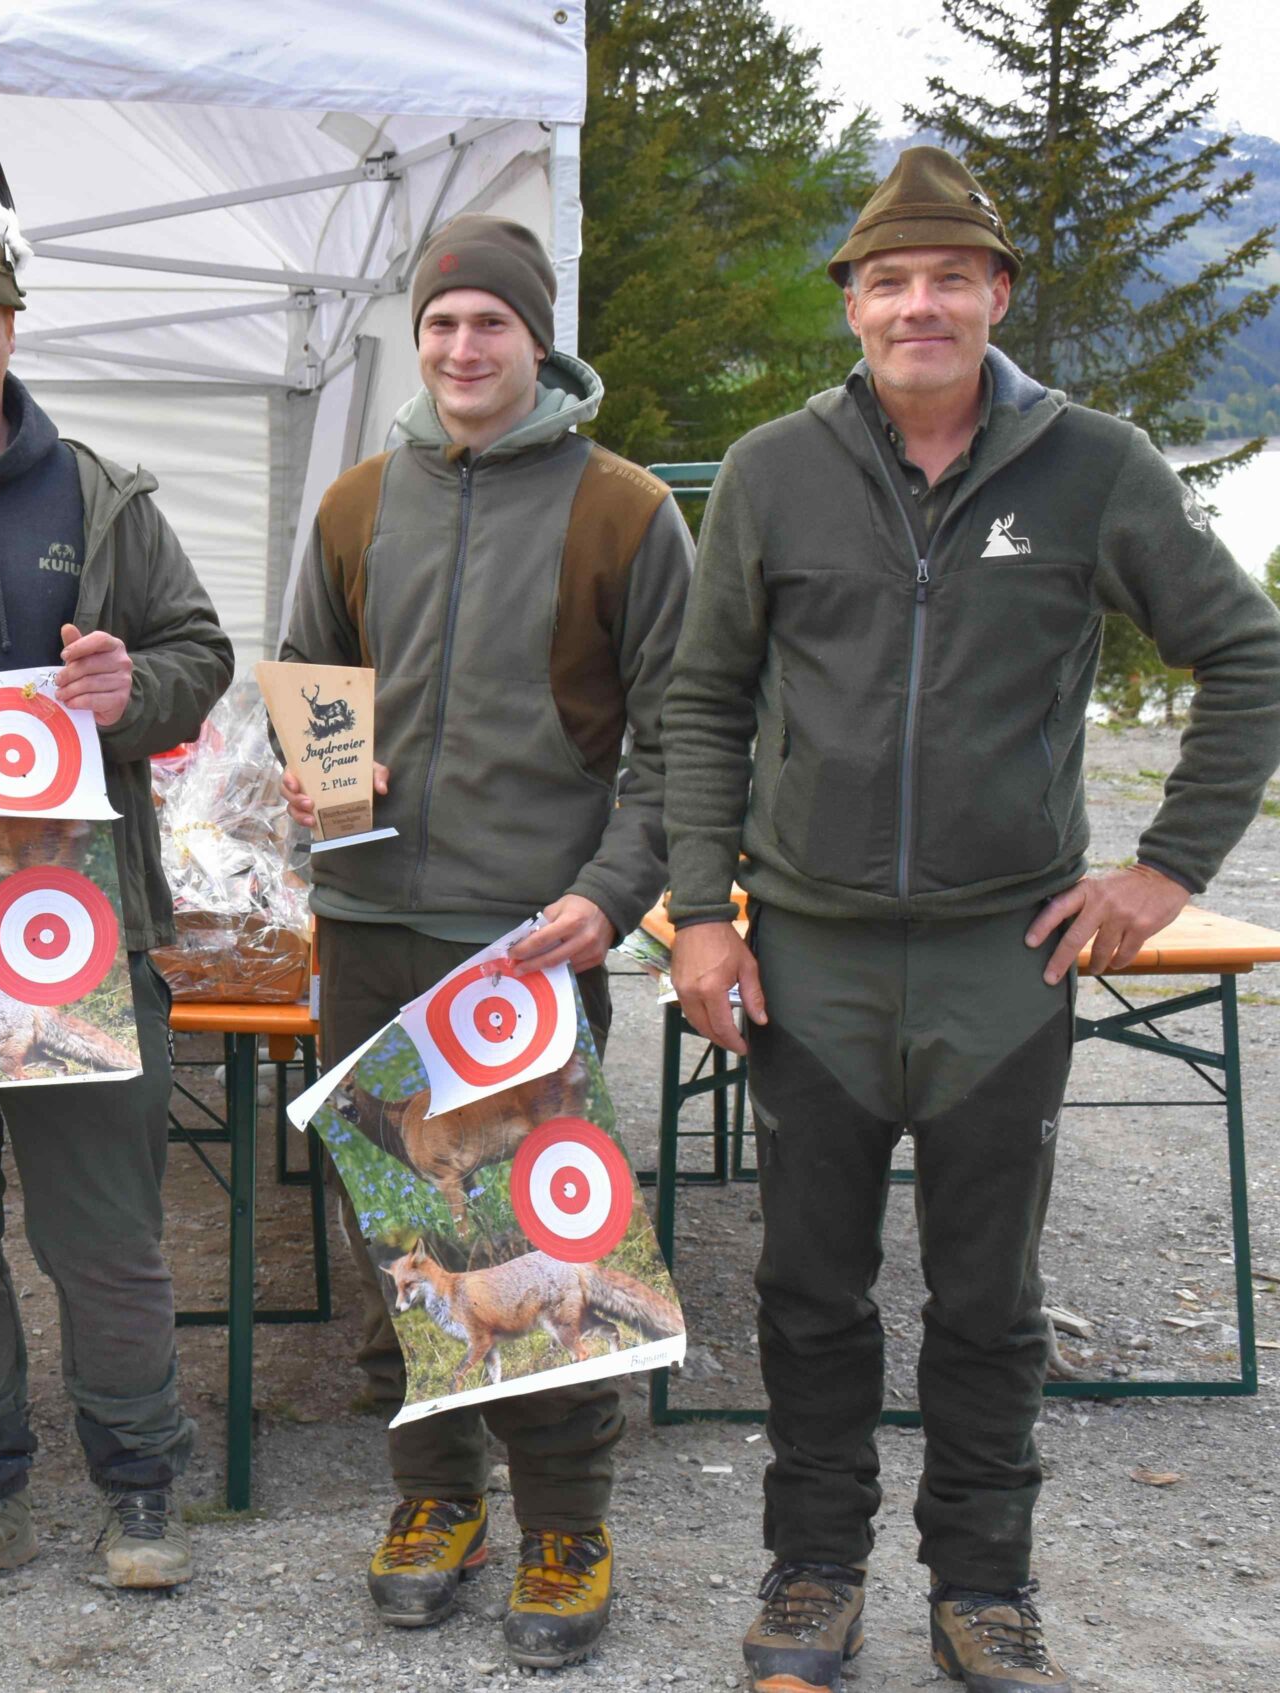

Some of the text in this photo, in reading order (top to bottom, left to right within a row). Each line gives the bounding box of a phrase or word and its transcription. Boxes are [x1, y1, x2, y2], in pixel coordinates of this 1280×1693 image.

[39, 557, 81, 576] KUIU
[301, 739, 365, 763] Jagdrevier
[321, 755, 358, 773] Graun
[321, 777, 357, 791] 2. Platz
